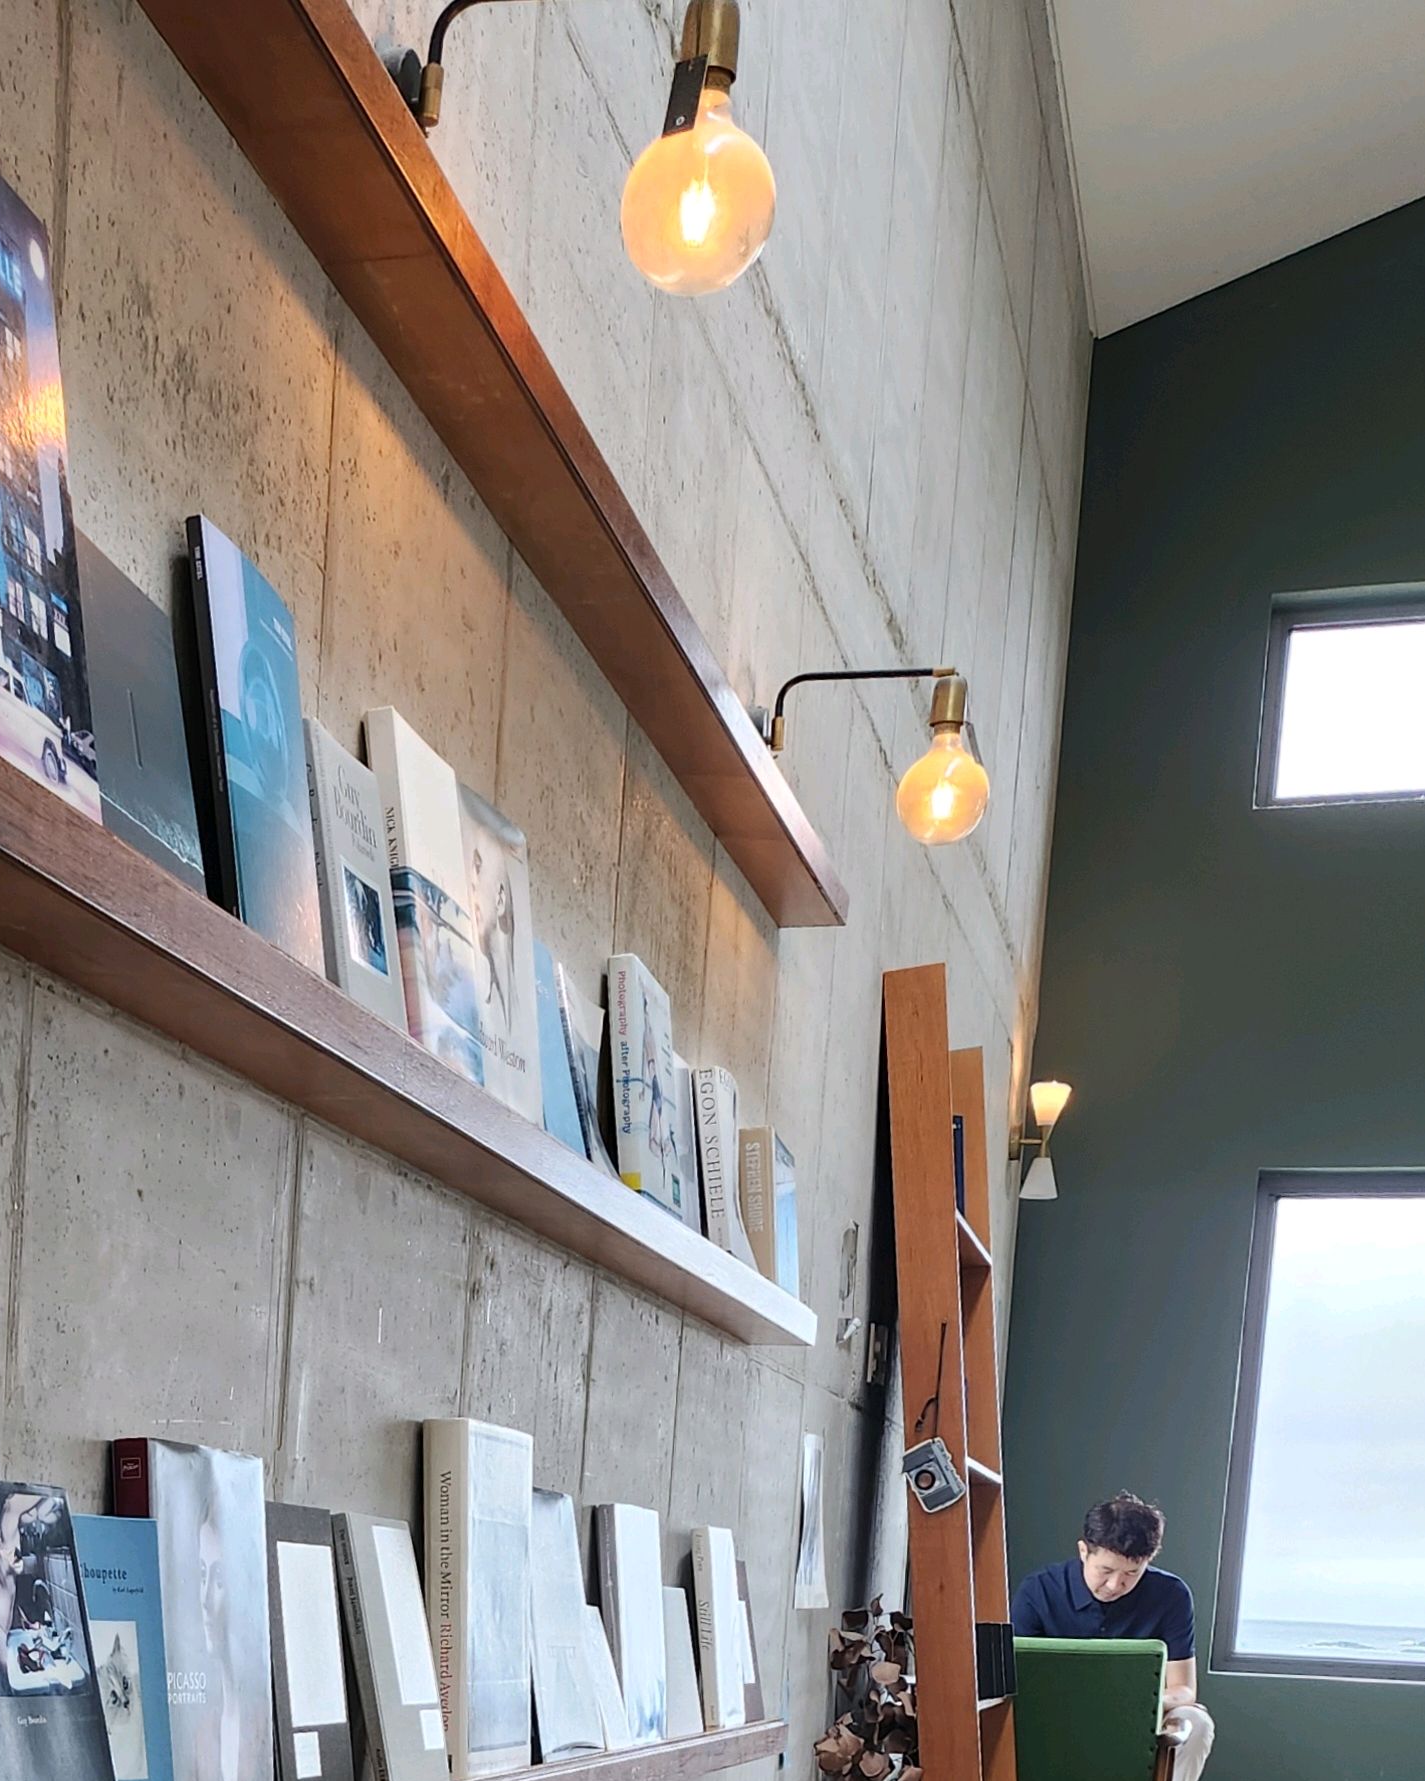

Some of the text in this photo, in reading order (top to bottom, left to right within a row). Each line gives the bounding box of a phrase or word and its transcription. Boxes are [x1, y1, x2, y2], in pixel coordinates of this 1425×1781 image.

[617, 971, 627, 1036] Photography
[698, 1068, 726, 1220] EGON SCHIELE
[439, 1471, 452, 1526] Woman
[440, 1528, 452, 1543] in
[80, 1562, 128, 1585] houpette
[439, 1546, 453, 1570] the
[439, 1571, 453, 1619] Mirror
[439, 1623, 453, 1679] Richard
[167, 1671, 207, 1690] PICASSO
[167, 1692, 207, 1705] PORTRAITS
